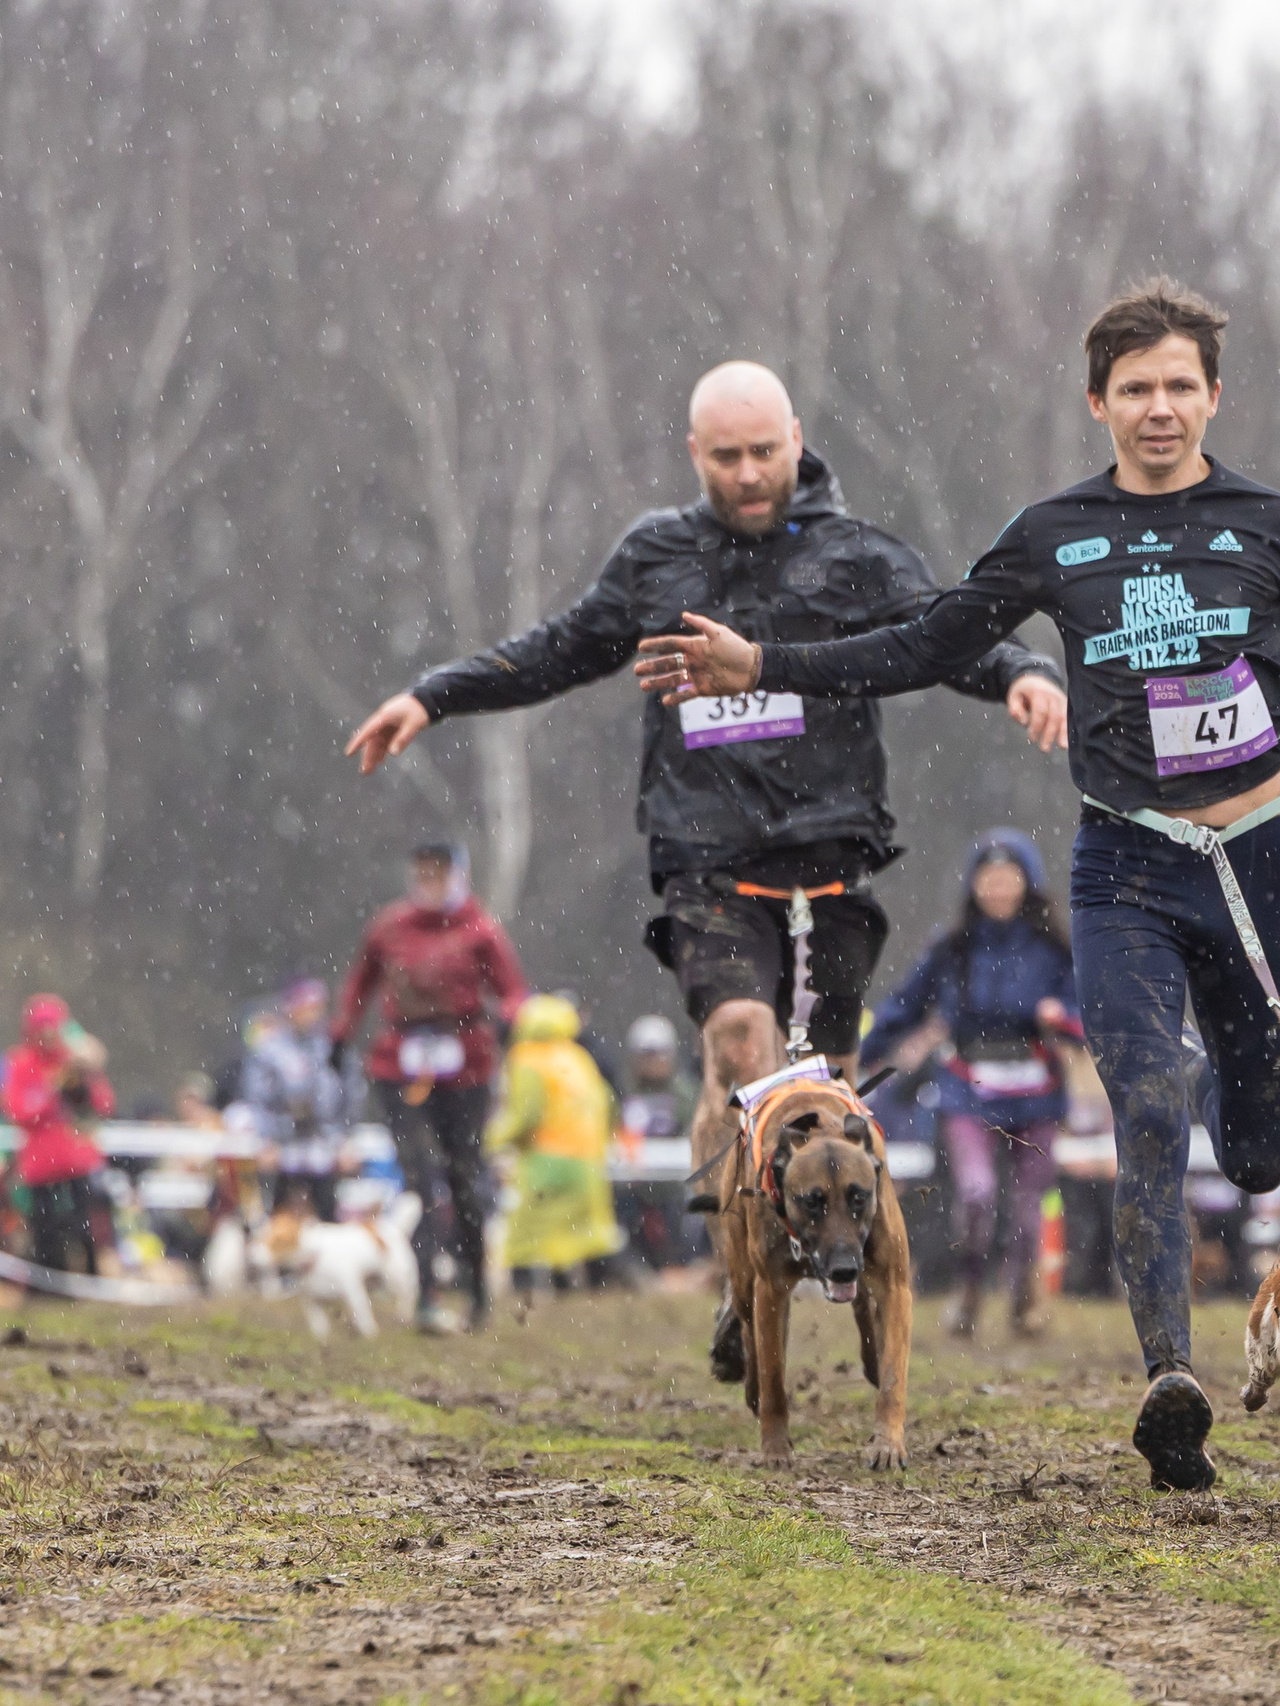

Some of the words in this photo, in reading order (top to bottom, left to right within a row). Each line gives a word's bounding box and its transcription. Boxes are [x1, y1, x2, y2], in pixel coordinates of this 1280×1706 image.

[1080, 547, 1101, 558] BCN
[1126, 543, 1174, 554] Santander
[1209, 543, 1243, 552] adidas
[1123, 573, 1187, 605] CURSA
[1121, 597, 1195, 630] NASSOS
[1093, 632, 1133, 658] TRAIEM
[1135, 628, 1158, 648] NAS
[1161, 614, 1230, 639] BARCELONA
[1128, 637, 1201, 670] 31.12.22
[1195, 704, 1239, 744] 47
